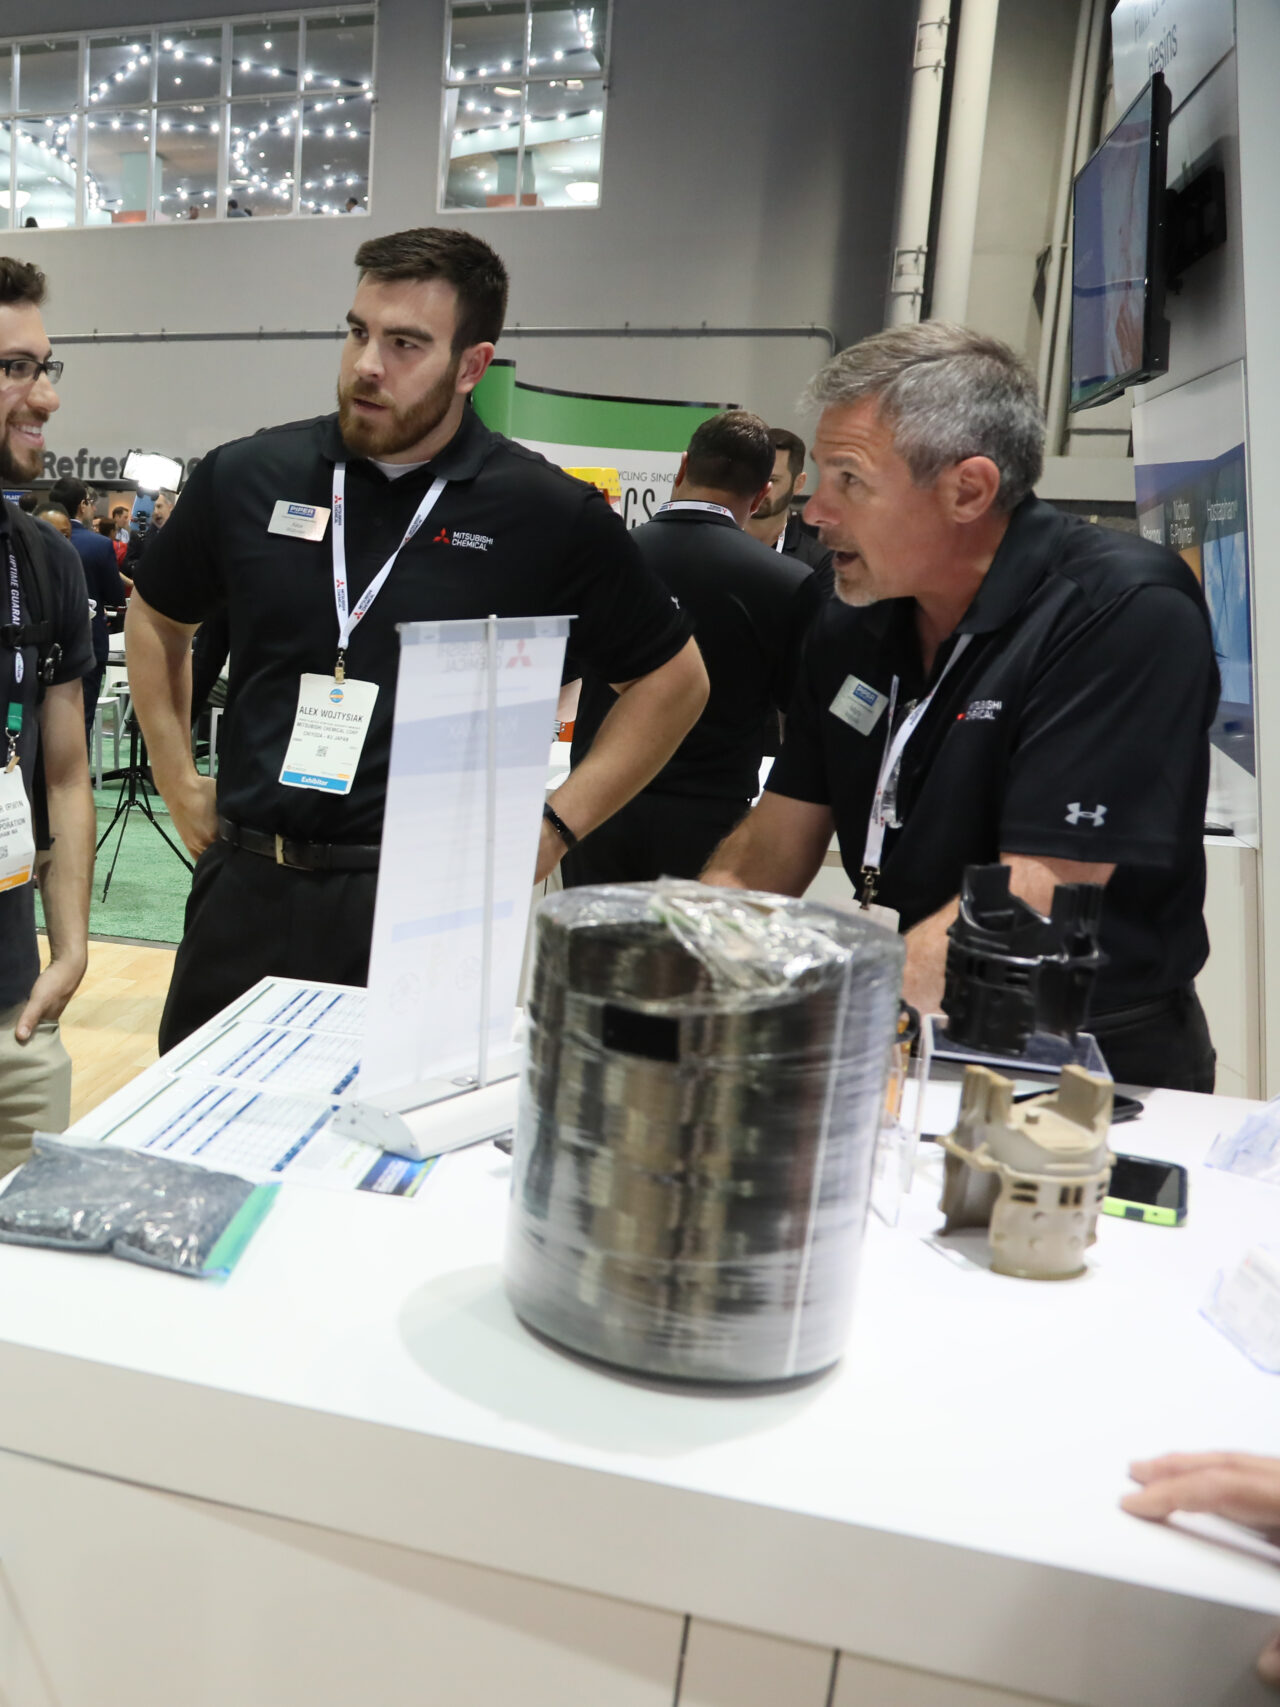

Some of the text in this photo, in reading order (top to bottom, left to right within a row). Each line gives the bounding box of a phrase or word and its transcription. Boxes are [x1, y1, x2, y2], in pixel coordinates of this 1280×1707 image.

[451, 538, 488, 551] CHEMICAL
[452, 531, 494, 545] MITSUBISHI
[8, 554, 19, 588] UPTIME
[299, 706, 318, 716] ALEX
